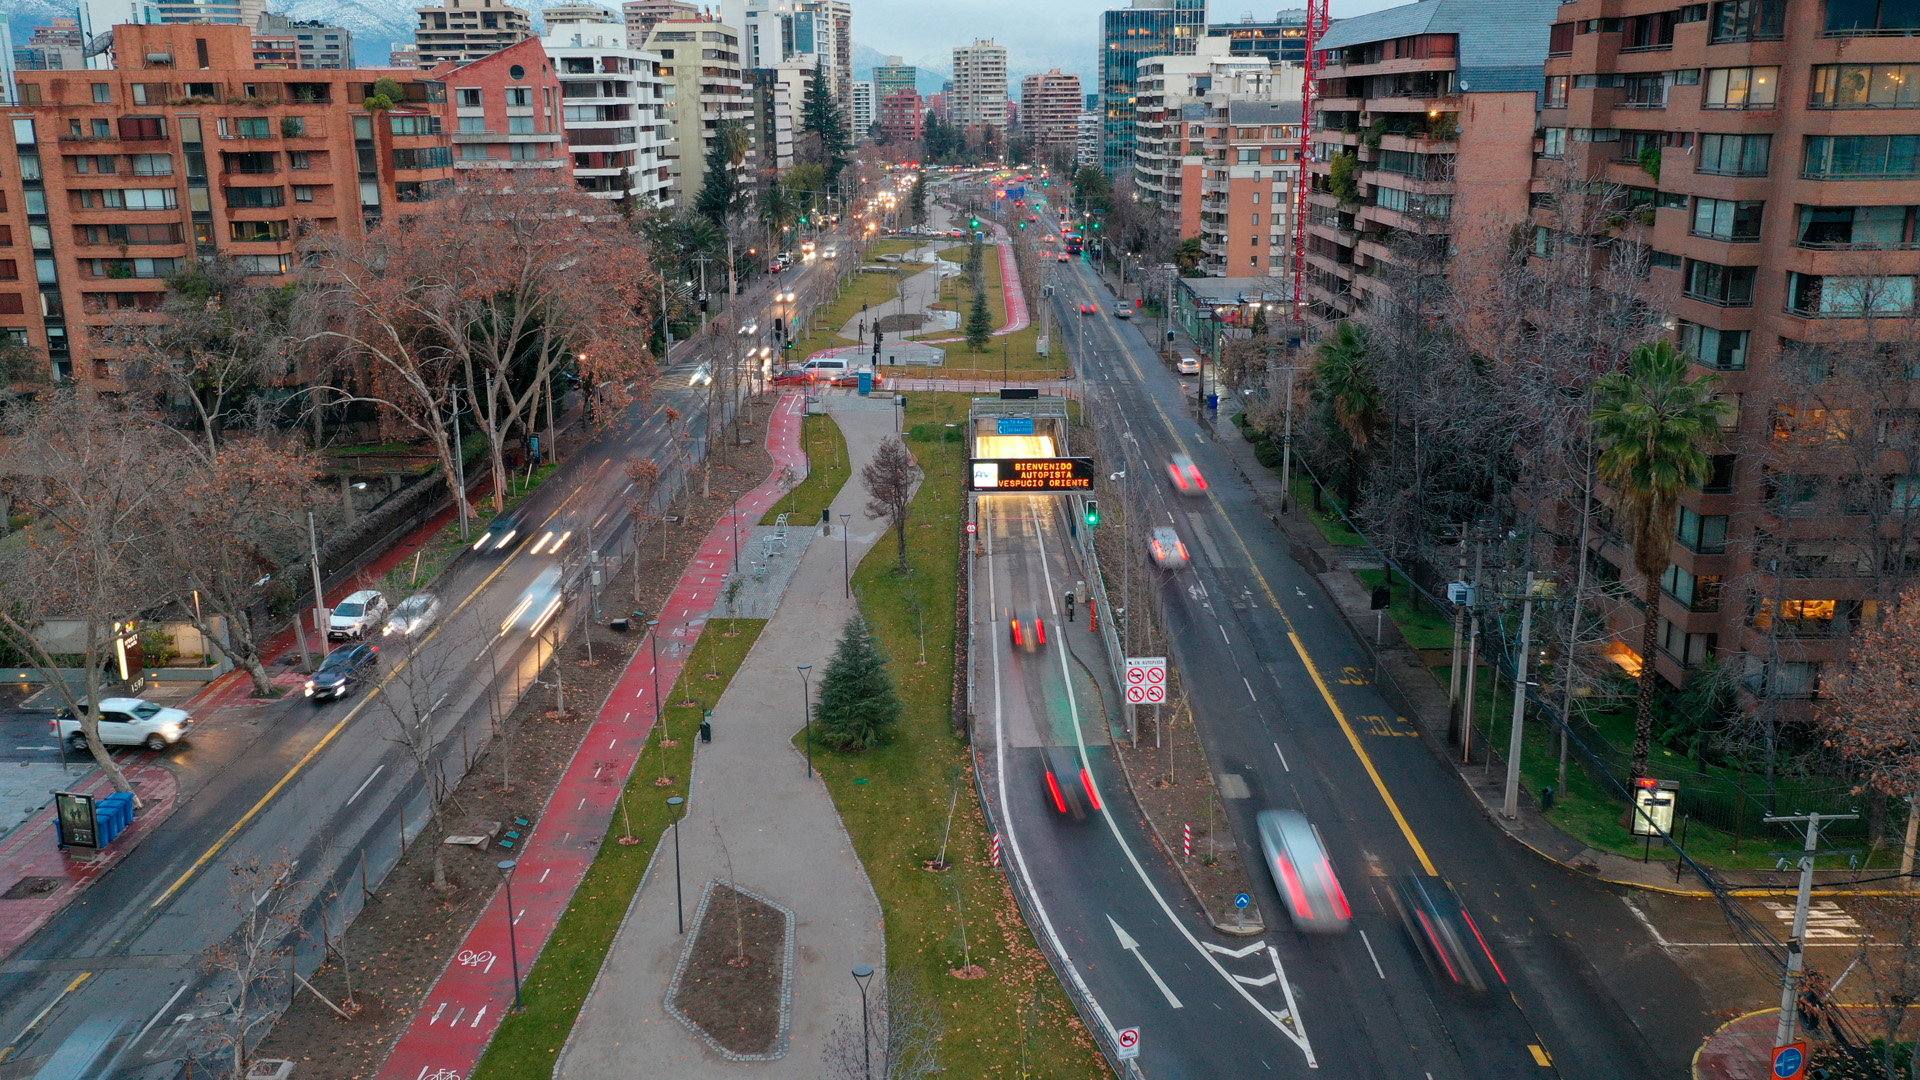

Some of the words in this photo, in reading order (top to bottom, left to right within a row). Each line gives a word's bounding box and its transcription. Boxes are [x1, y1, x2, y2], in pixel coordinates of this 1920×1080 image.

[1014, 463, 1073, 471] BIENVENIDO
[1021, 471, 1072, 479] AUTOPISTA
[998, 479, 1044, 487] VESPUCIO
[1049, 479, 1089, 487] ORIENTE
[130, 677, 144, 693] 1597
